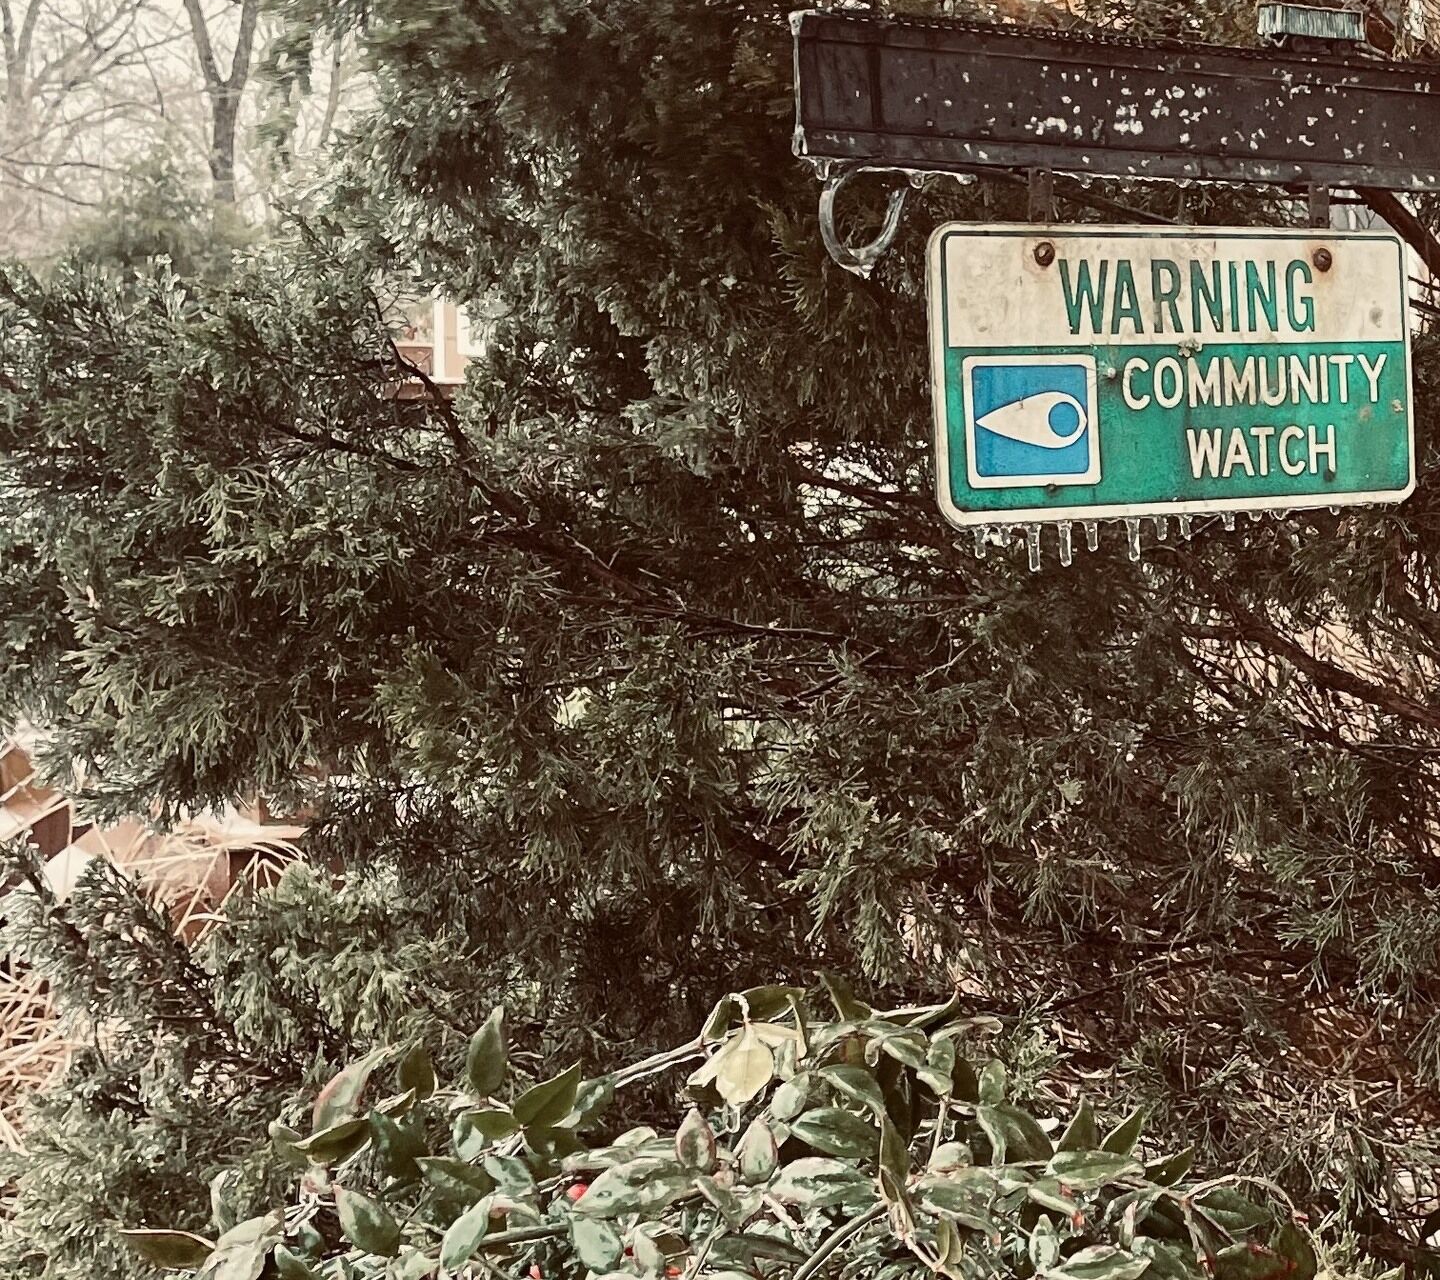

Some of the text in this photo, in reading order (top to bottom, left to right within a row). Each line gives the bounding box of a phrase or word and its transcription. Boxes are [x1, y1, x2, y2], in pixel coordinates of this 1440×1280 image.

[1058, 258, 1316, 335] WARNING
[1121, 353, 1388, 410] COMMUNITY
[1186, 424, 1337, 479] WATCH
